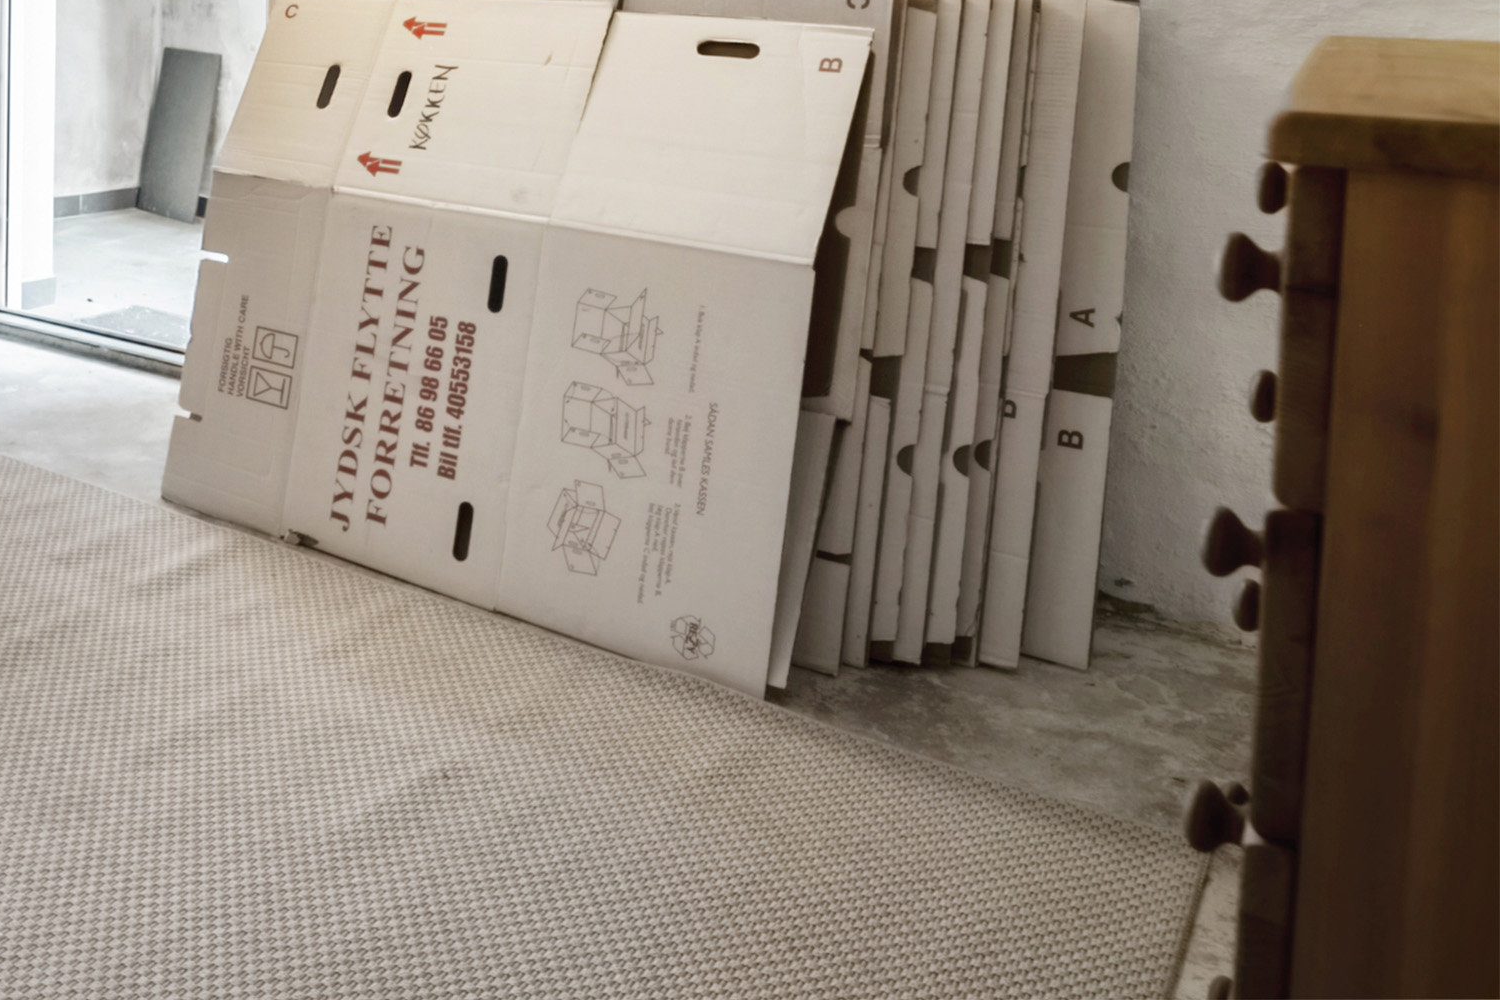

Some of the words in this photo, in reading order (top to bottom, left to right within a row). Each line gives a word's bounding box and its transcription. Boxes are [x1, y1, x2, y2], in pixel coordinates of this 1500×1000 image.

[285, 4, 299, 18] C
[819, 57, 843, 73] B
[409, 64, 459, 150] KØKKEN
[238, 294, 249, 323] CARE
[1069, 308, 1095, 328] A
[234, 325, 244, 352] WITH
[428, 315, 448, 342] 05
[218, 337, 232, 393] FORSIGTIG
[236, 345, 250, 397] VORSICHT
[424, 345, 444, 372] 66
[446, 321, 477, 420] 40553158
[227, 353, 240, 396] HANDLE
[330, 392, 368, 532] JYDSK
[351, 225, 392, 384] FLYTTE
[365, 246, 425, 529] FORRETNING
[419, 376, 440, 402] 98
[415, 406, 436, 432] 86
[706, 402, 719, 437] SÅDAN
[442, 425, 462, 449] tlf.
[1057, 429, 1084, 449] B
[410, 442, 431, 468] Tlf.
[437, 451, 458, 480] Bil
[701, 439, 713, 475] SAMLES
[696, 477, 708, 515] KASSEN
